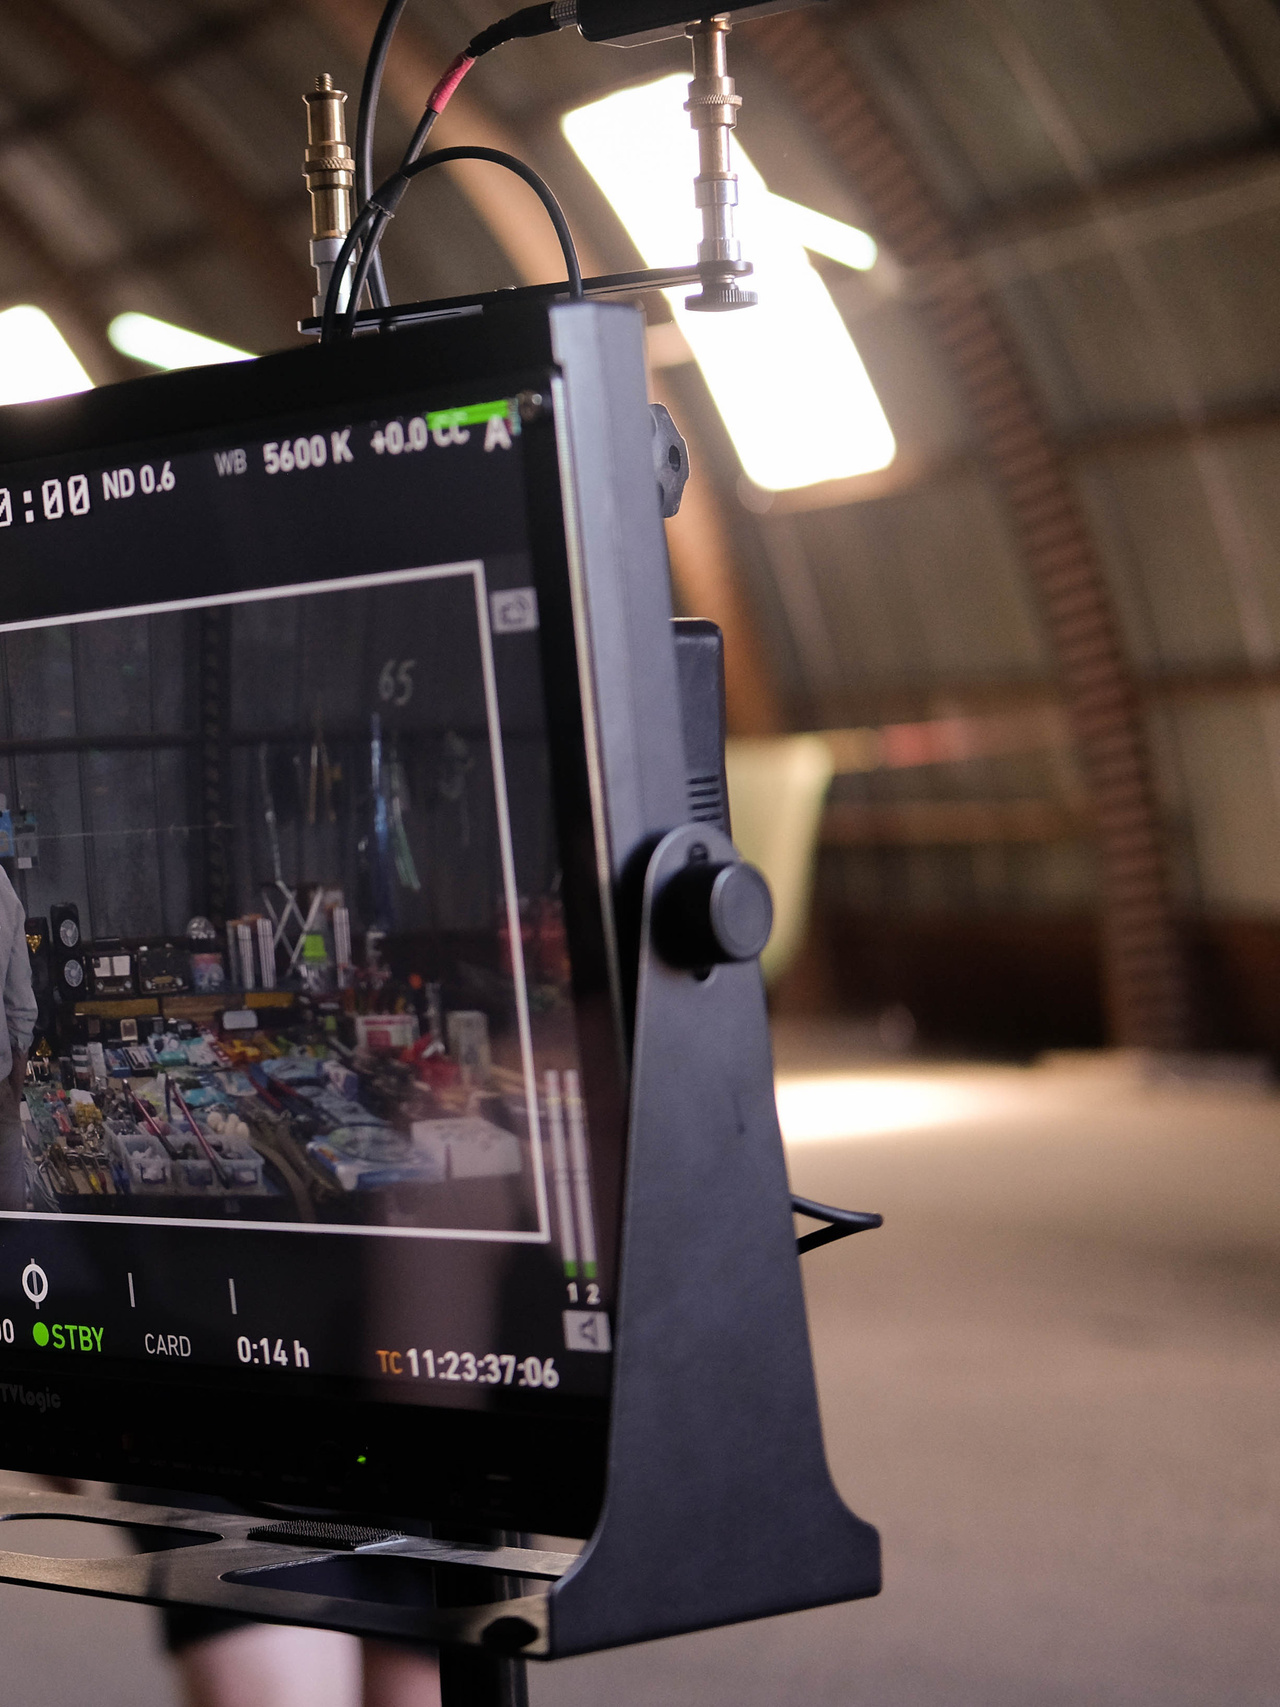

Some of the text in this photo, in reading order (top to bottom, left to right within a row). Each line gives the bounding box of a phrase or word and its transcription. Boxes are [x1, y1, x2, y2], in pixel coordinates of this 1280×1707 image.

[214, 429, 354, 477] WB 5600 K
[102, 461, 176, 501] ND 0.6
[378, 659, 417, 705] 65
[565, 1281, 602, 1306] 1 2
[51, 1323, 105, 1353] STBY
[144, 1332, 311, 1369] CARD 0:14 h
[376, 1347, 560, 1389] TC 11:23:37:06
